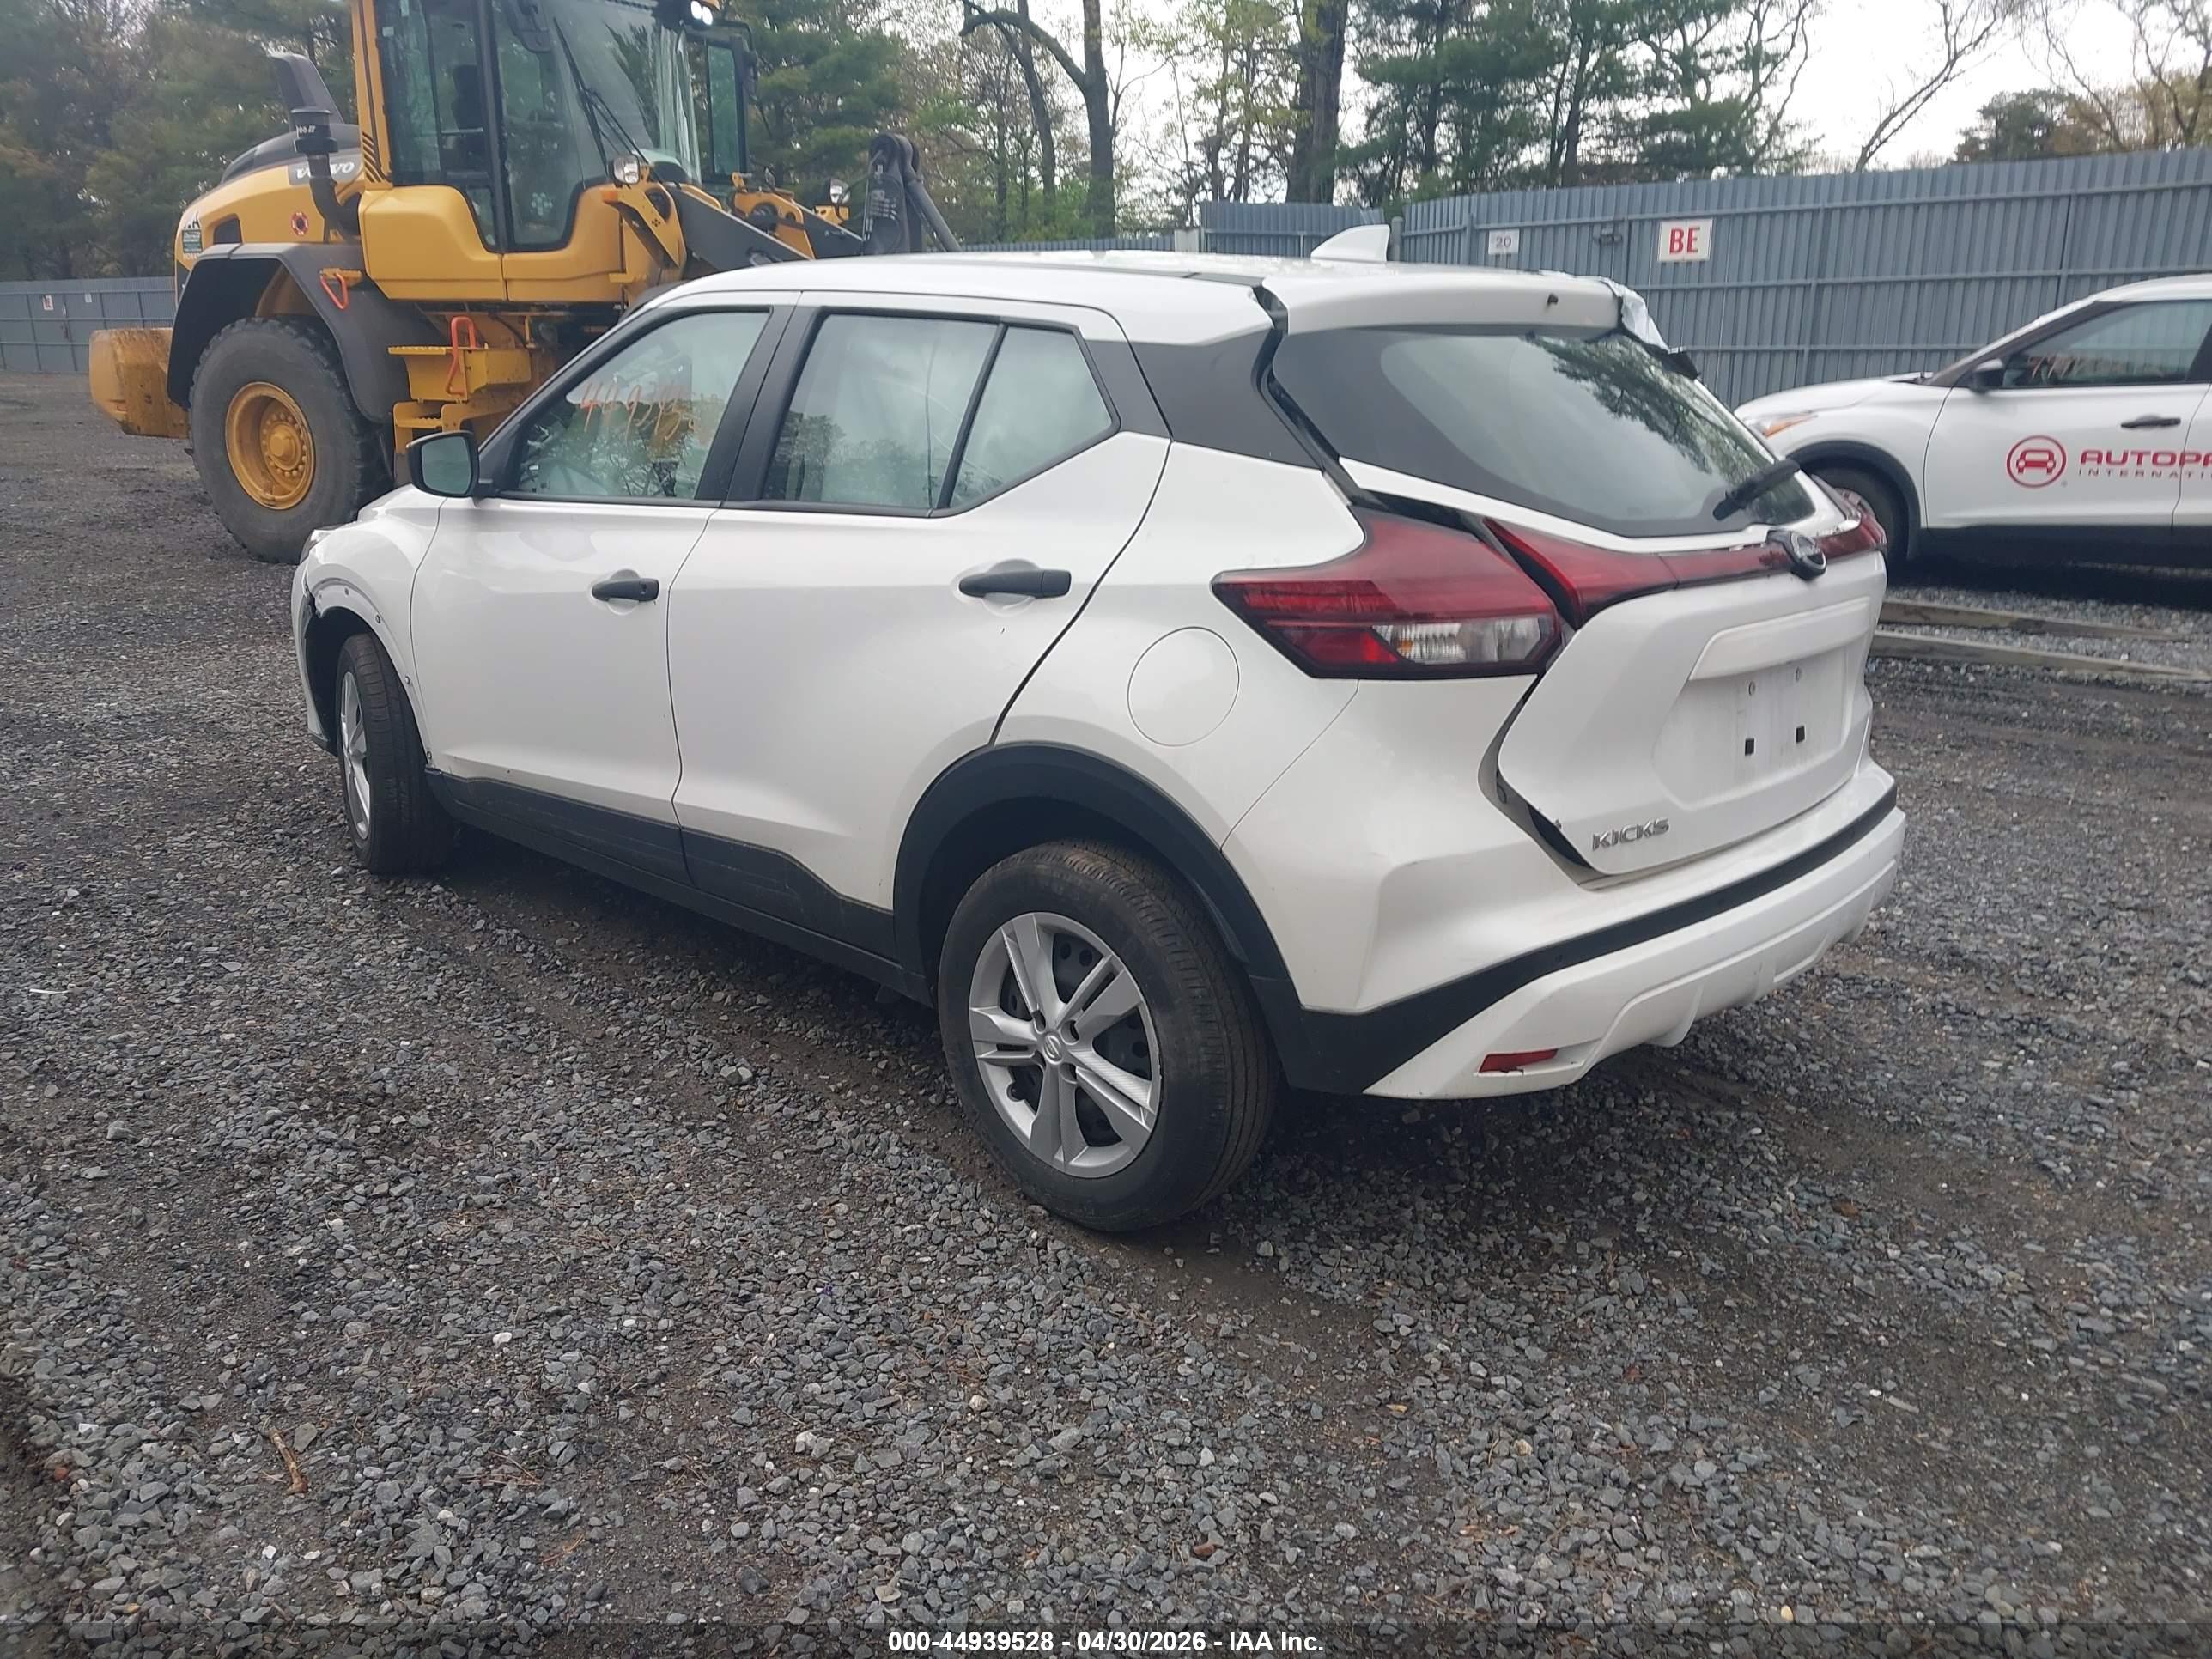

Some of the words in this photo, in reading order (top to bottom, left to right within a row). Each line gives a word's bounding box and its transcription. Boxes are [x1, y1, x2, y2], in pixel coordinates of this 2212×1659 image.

[296, 161, 356, 179] VVO
[1494, 235, 1513, 249] 20
[1668, 226, 1701, 254] BE
[2078, 469, 2212, 479] INTERNATI
[1591, 817, 1670, 851] KICKS
